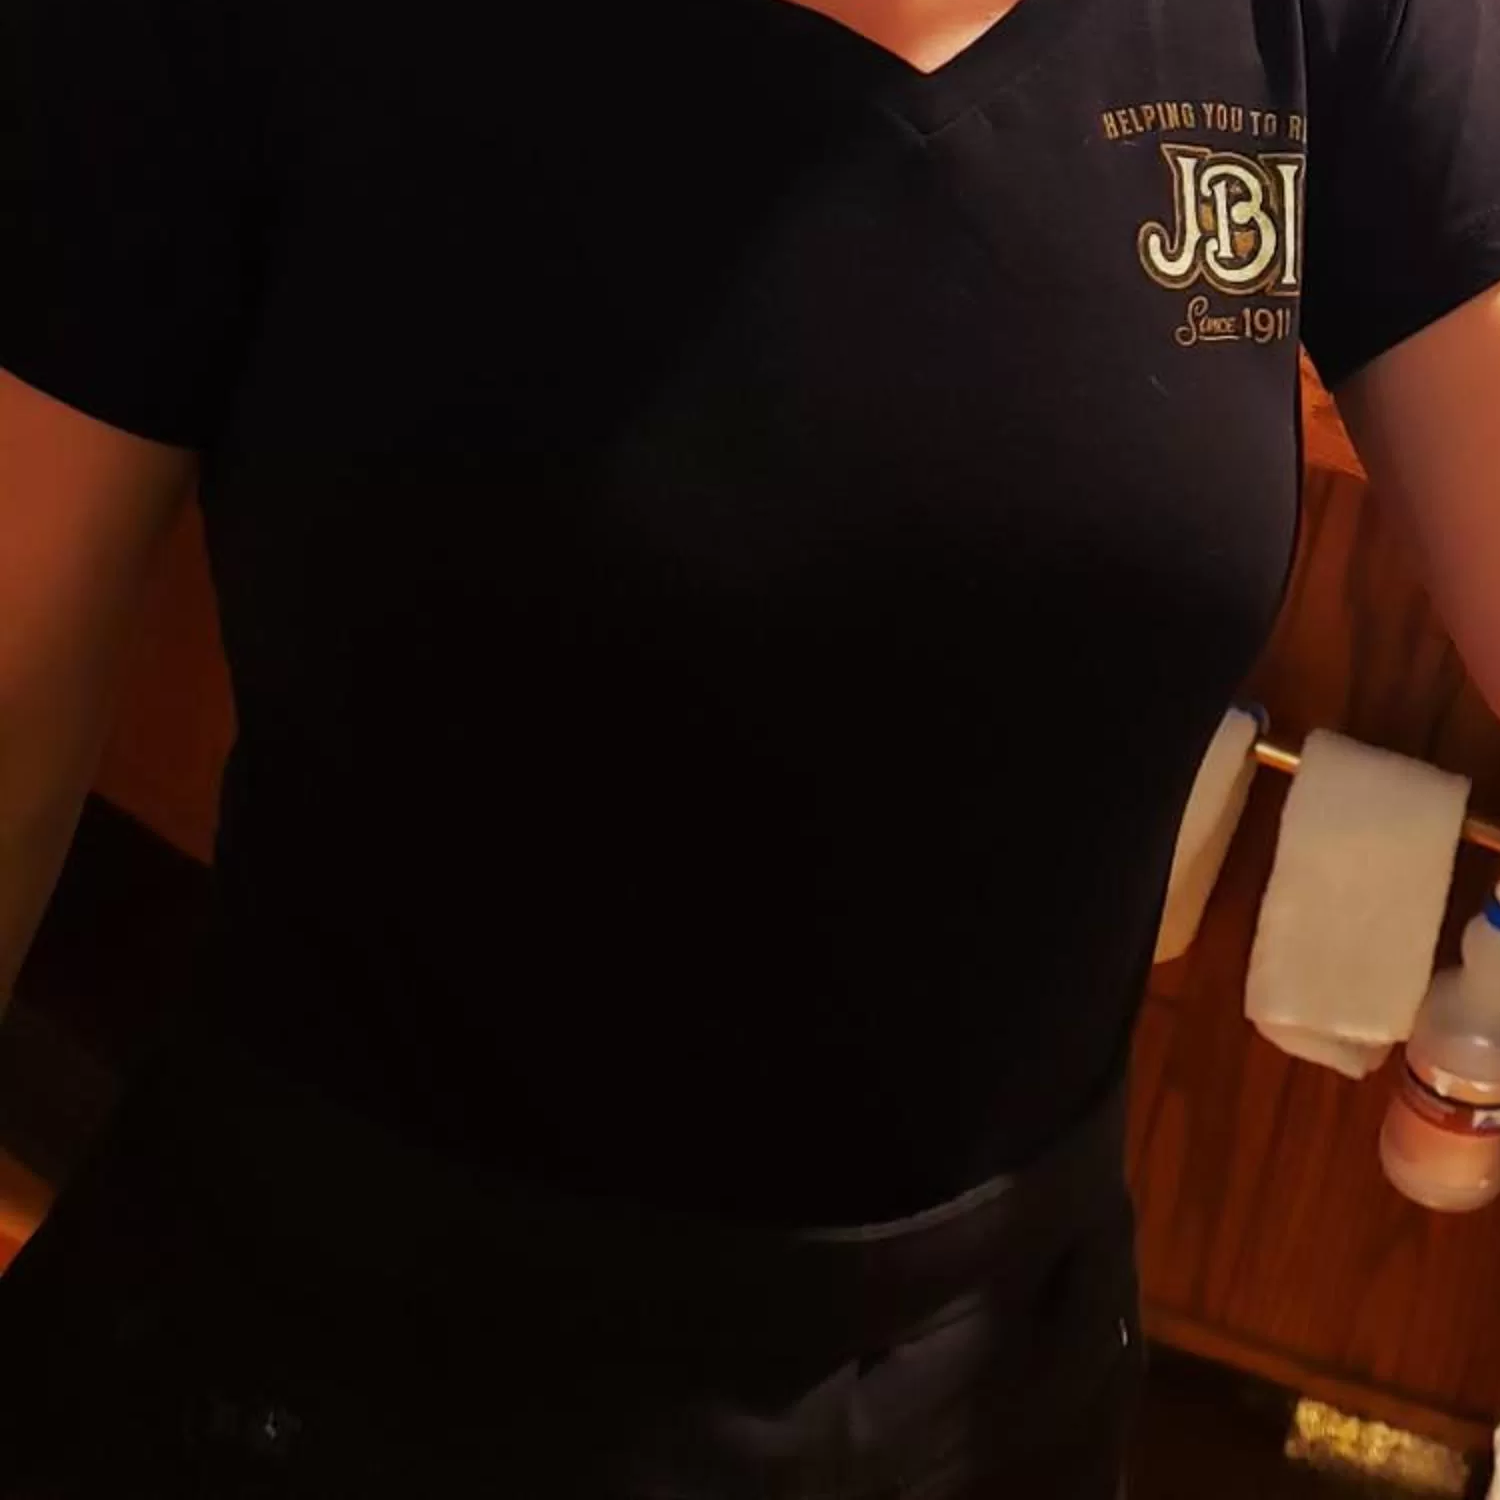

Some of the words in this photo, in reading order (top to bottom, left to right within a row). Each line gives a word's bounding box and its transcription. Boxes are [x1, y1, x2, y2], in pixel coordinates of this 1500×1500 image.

[1102, 100, 1197, 141] HELPING
[1202, 102, 1244, 133] YOU
[1249, 109, 1278, 137] TO
[1140, 144, 1305, 296] JBI
[1240, 306, 1292, 343] 1911
